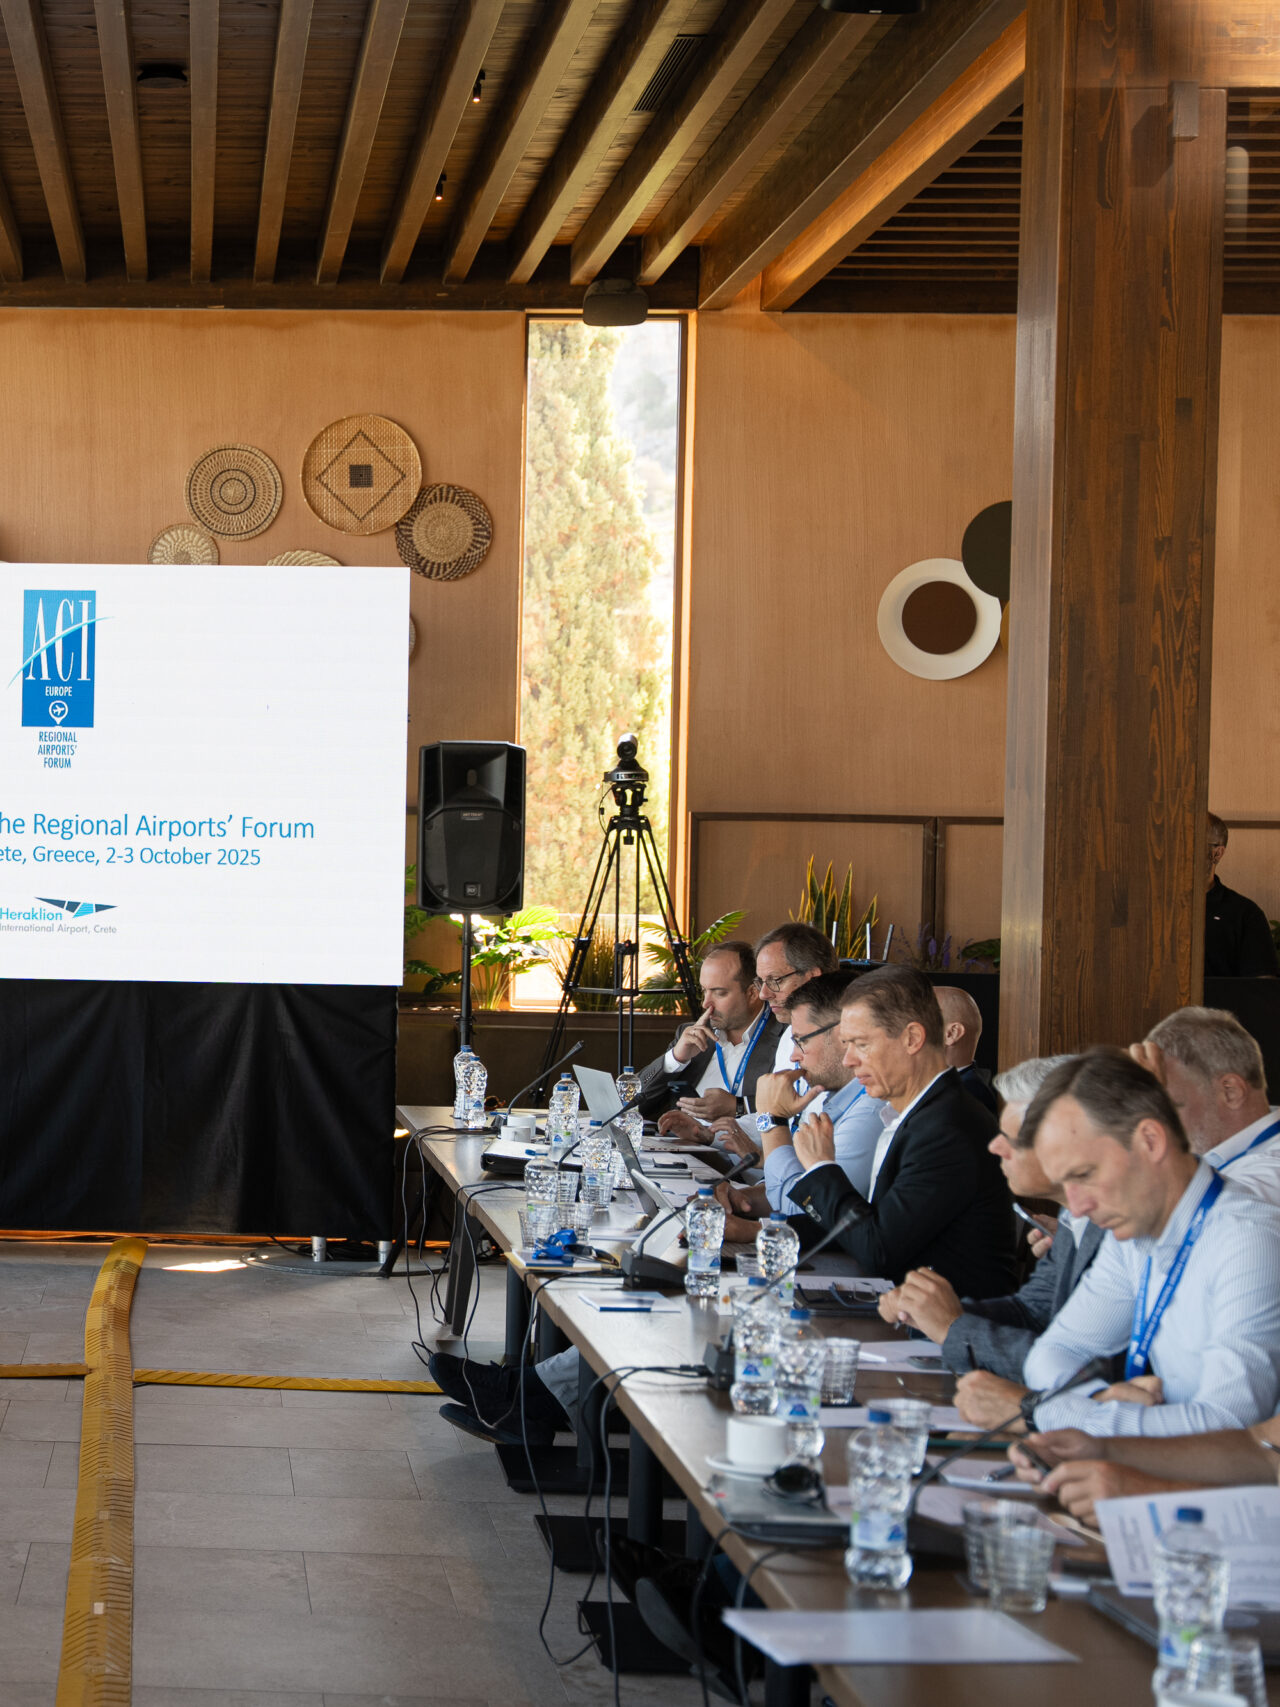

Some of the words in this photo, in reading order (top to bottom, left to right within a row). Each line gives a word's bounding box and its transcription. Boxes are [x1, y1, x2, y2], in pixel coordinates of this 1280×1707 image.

[25, 597, 93, 682] ACI
[45, 686, 73, 697] EUROPE
[38, 731, 78, 743] REGIONAL
[43, 757, 72, 769] FORUM
[33, 812, 129, 840] Regional
[241, 816, 315, 839] Forum
[32, 845, 100, 866] Greece,
[105, 846, 134, 864] 2-3
[139, 846, 212, 865] October
[216, 848, 261, 866] 2025
[0, 907, 63, 921] Heraklion
[0, 923, 55, 933] International
[57, 923, 90, 935] Airport,
[93, 924, 117, 934] Crete
